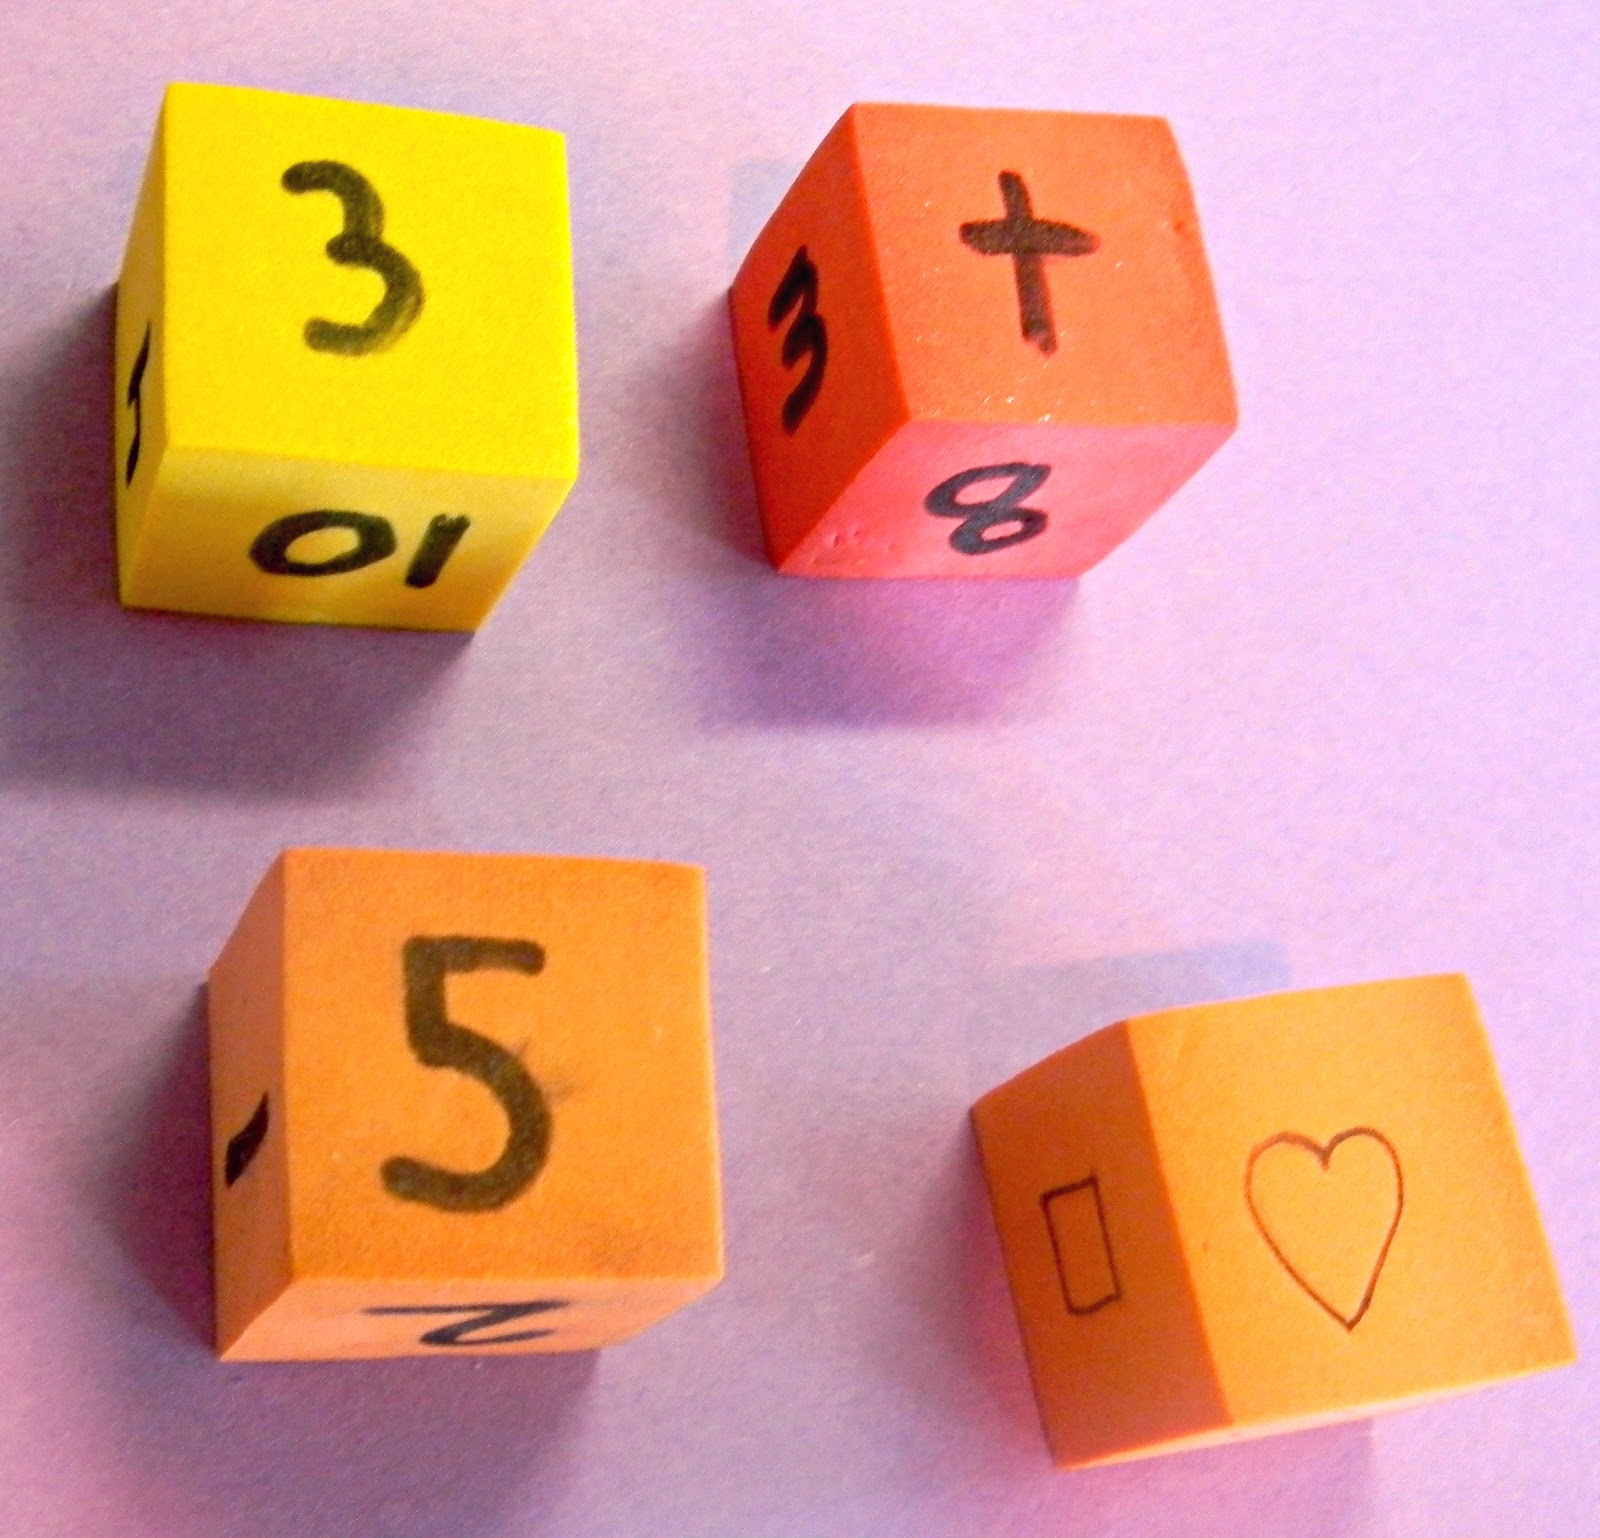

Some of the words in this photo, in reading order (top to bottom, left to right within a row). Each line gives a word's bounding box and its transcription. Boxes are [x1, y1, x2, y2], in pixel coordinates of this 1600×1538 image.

[280, 159, 425, 356] 3
[768, 244, 829, 435] 3
[922, 461, 1052, 556] 8
[378, 933, 553, 1215] 5
